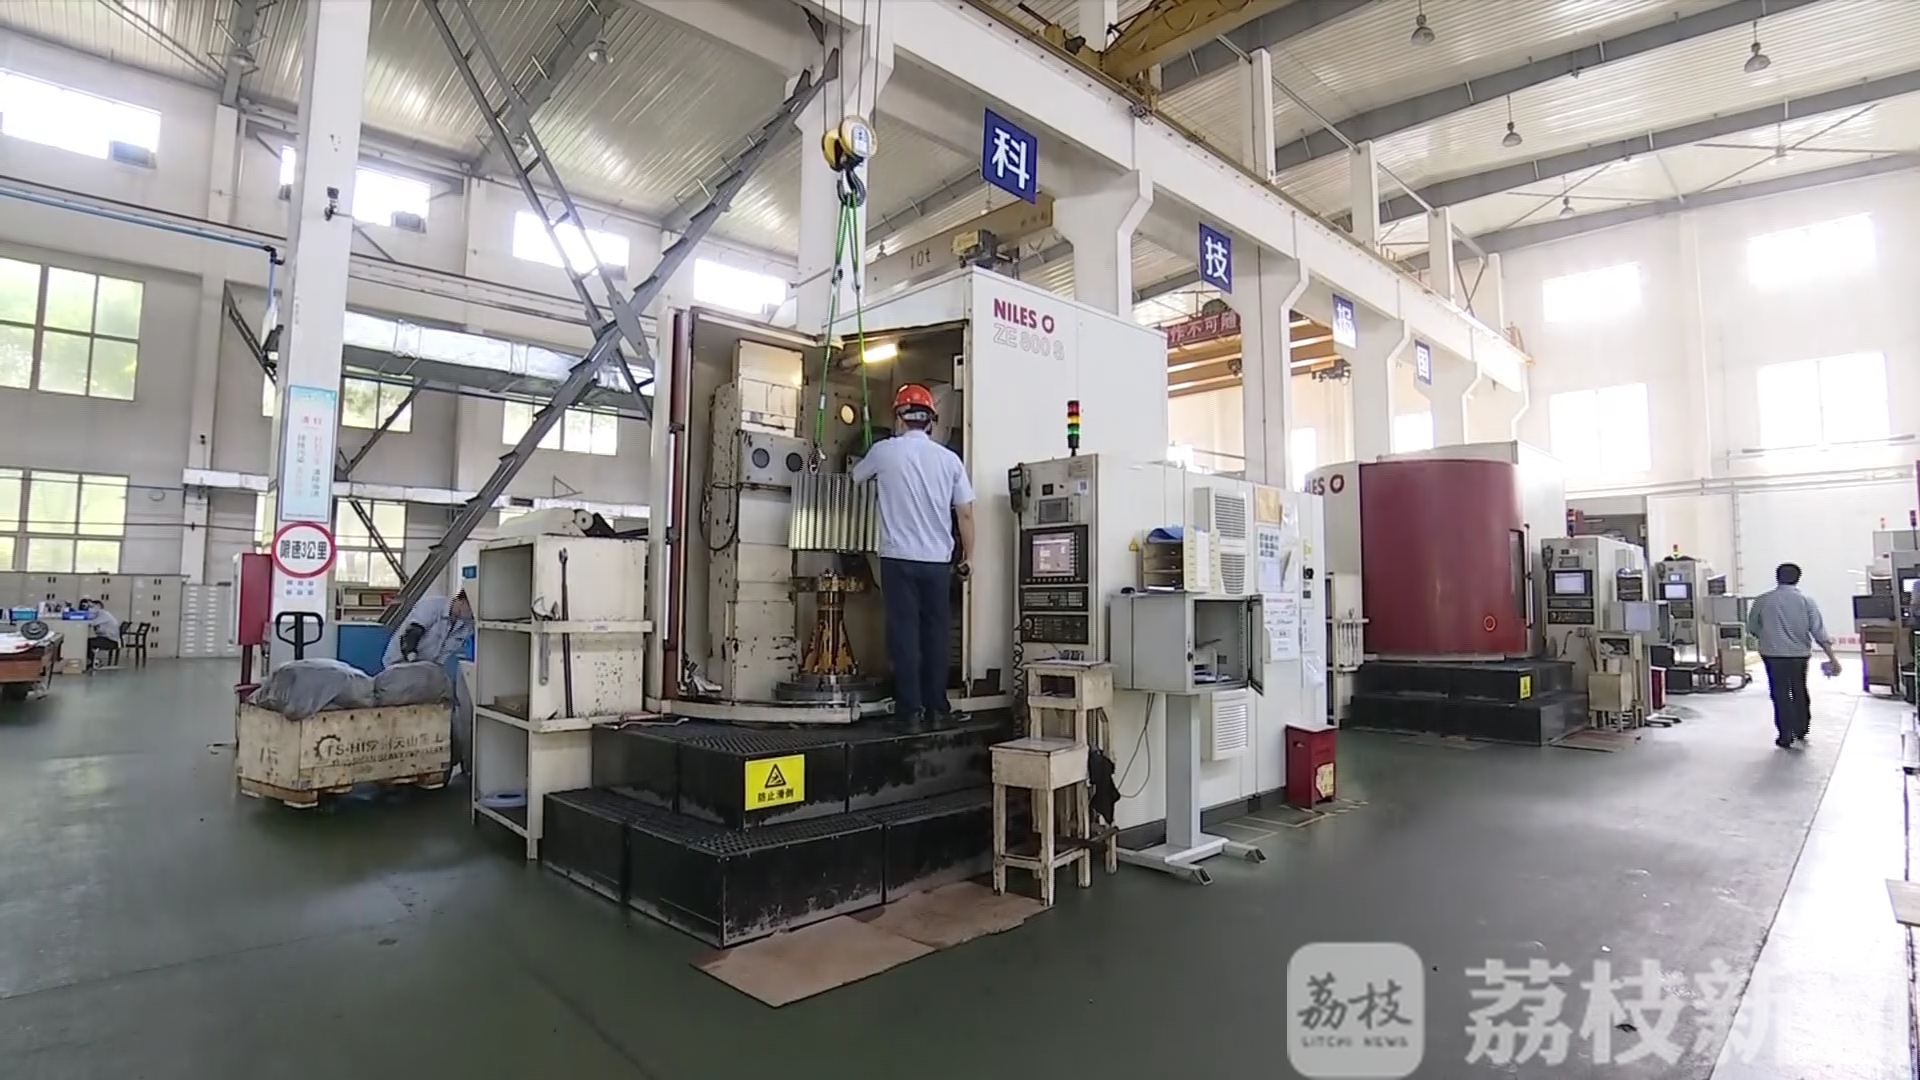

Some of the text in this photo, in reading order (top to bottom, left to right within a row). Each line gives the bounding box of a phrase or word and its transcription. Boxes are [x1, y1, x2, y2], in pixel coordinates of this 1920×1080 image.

[991, 127, 1030, 190] 科
[910, 249, 931, 270] 10t
[1205, 236, 1229, 284] 技
[993, 298, 1038, 329] NILES
[993, 322, 1018, 348] ZE
[1020, 331, 1051, 357] 800
[280, 540, 327, 560] 限速3公里
[757, 788, 794, 802] 防止滑倒
